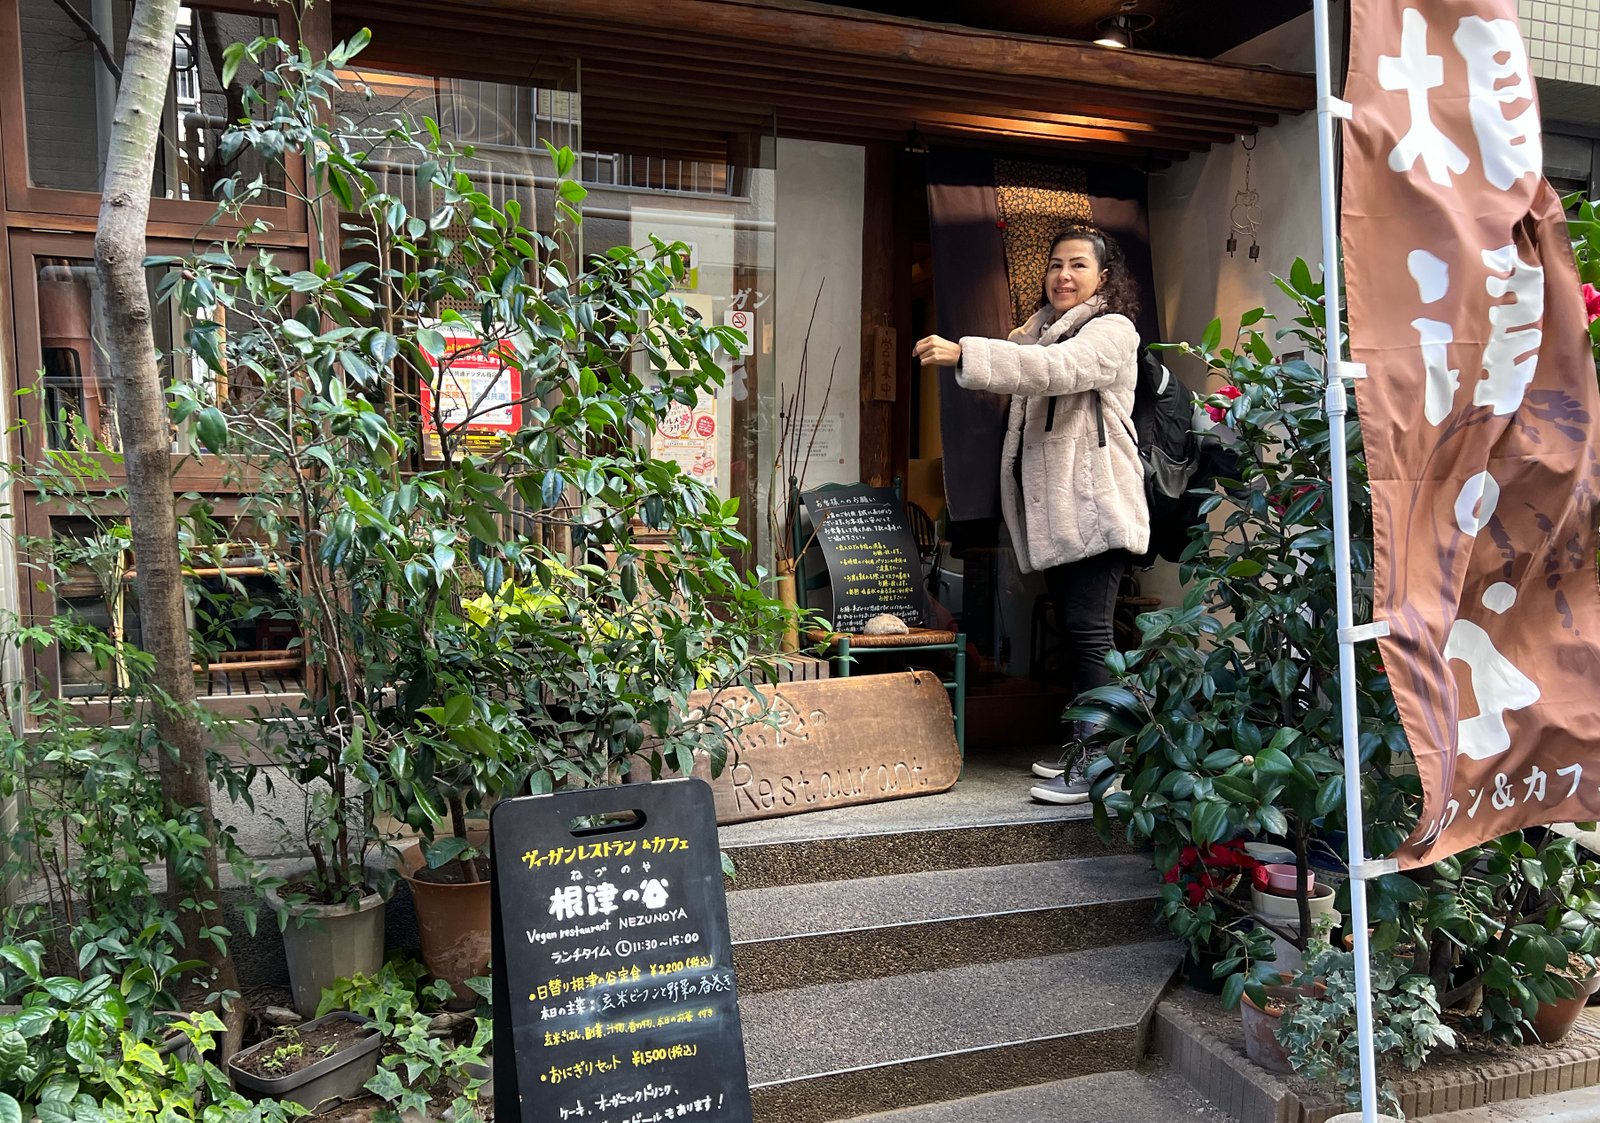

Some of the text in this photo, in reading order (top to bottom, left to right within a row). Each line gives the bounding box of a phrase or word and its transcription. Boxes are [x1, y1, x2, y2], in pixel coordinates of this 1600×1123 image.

[730, 757, 928, 813] Restaurant
[570, 861, 651, 882] ねづのや
[548, 878, 669, 921] 根津の谷
[526, 929, 558, 945] Vegan
[559, 919, 612, 940] restaurant
[550, 946, 612, 965] ランチタイム
